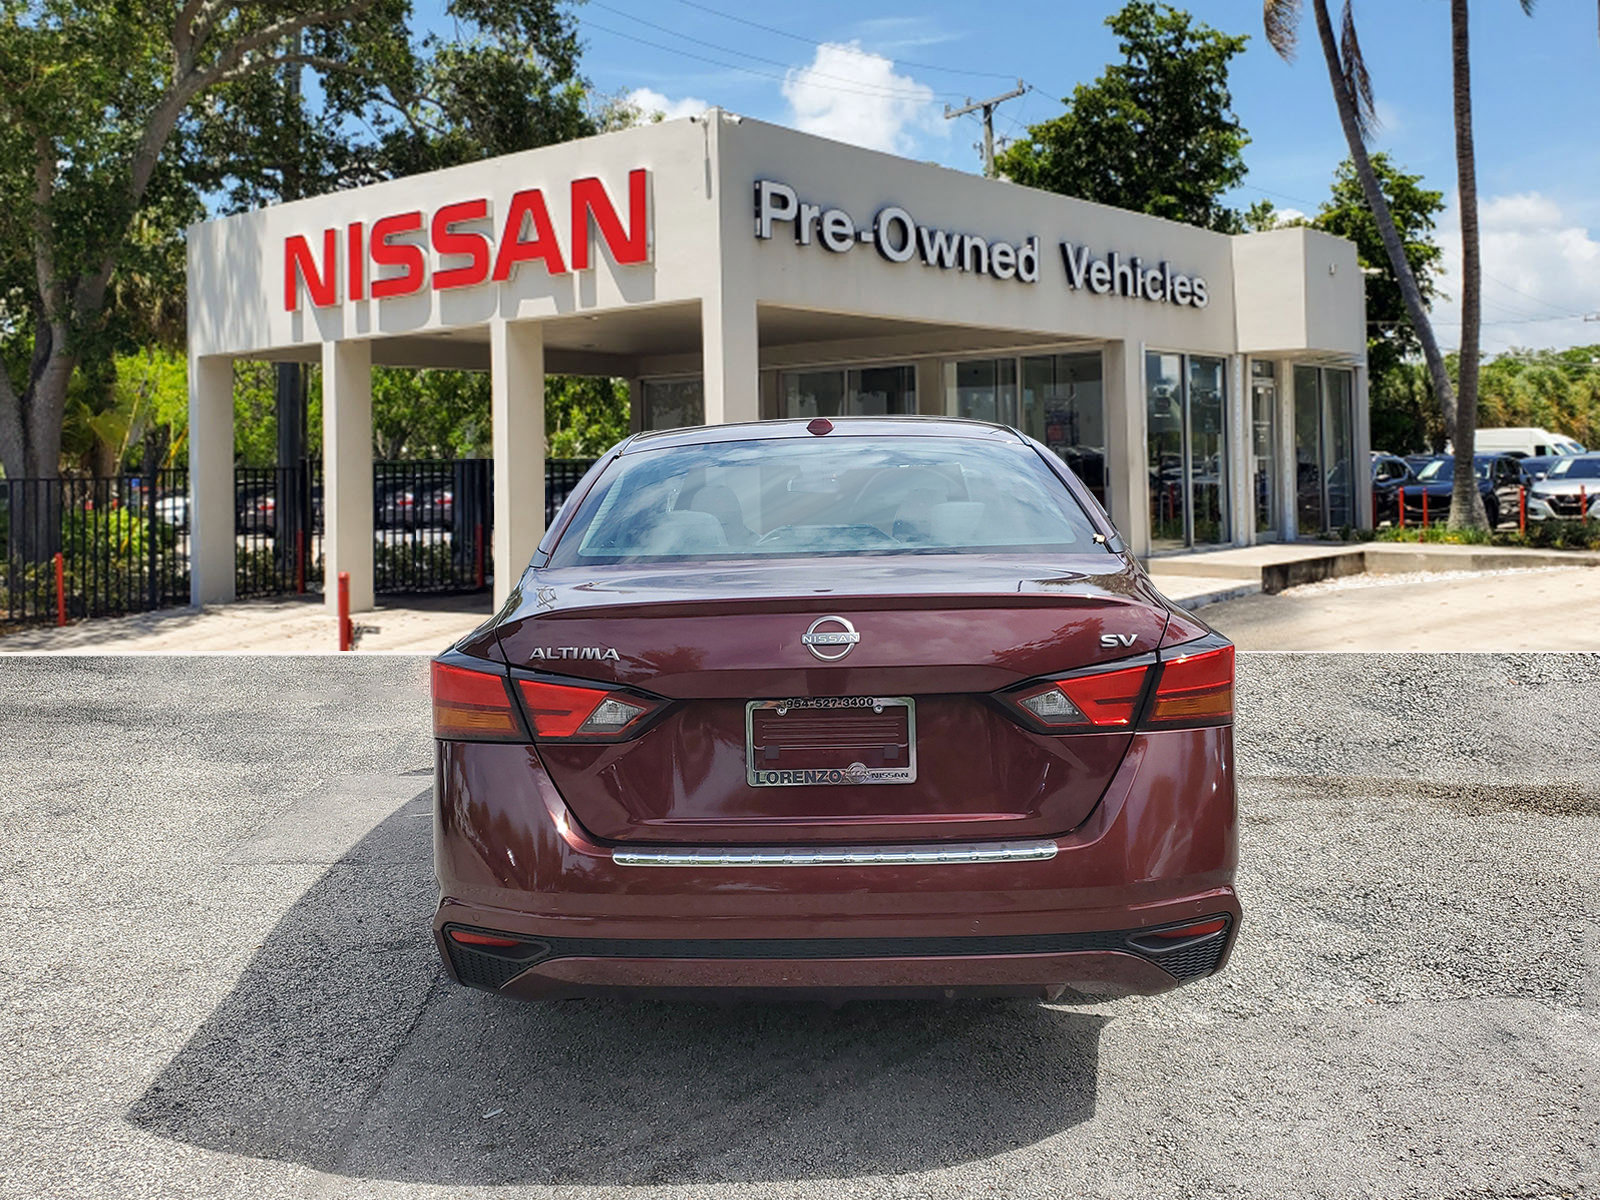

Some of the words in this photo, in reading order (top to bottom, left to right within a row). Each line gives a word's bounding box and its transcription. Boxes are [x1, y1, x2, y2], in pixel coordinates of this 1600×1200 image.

[285, 168, 649, 312] NISSAN
[755, 180, 1040, 282] Pre-Owned
[1061, 241, 1208, 308] Vehicles
[803, 634, 858, 643] NISSAN
[1100, 634, 1138, 648] SV
[529, 647, 620, 661] ALTIMA
[786, 698, 874, 709] 954-527-3400
[755, 770, 843, 785] LORENZO
